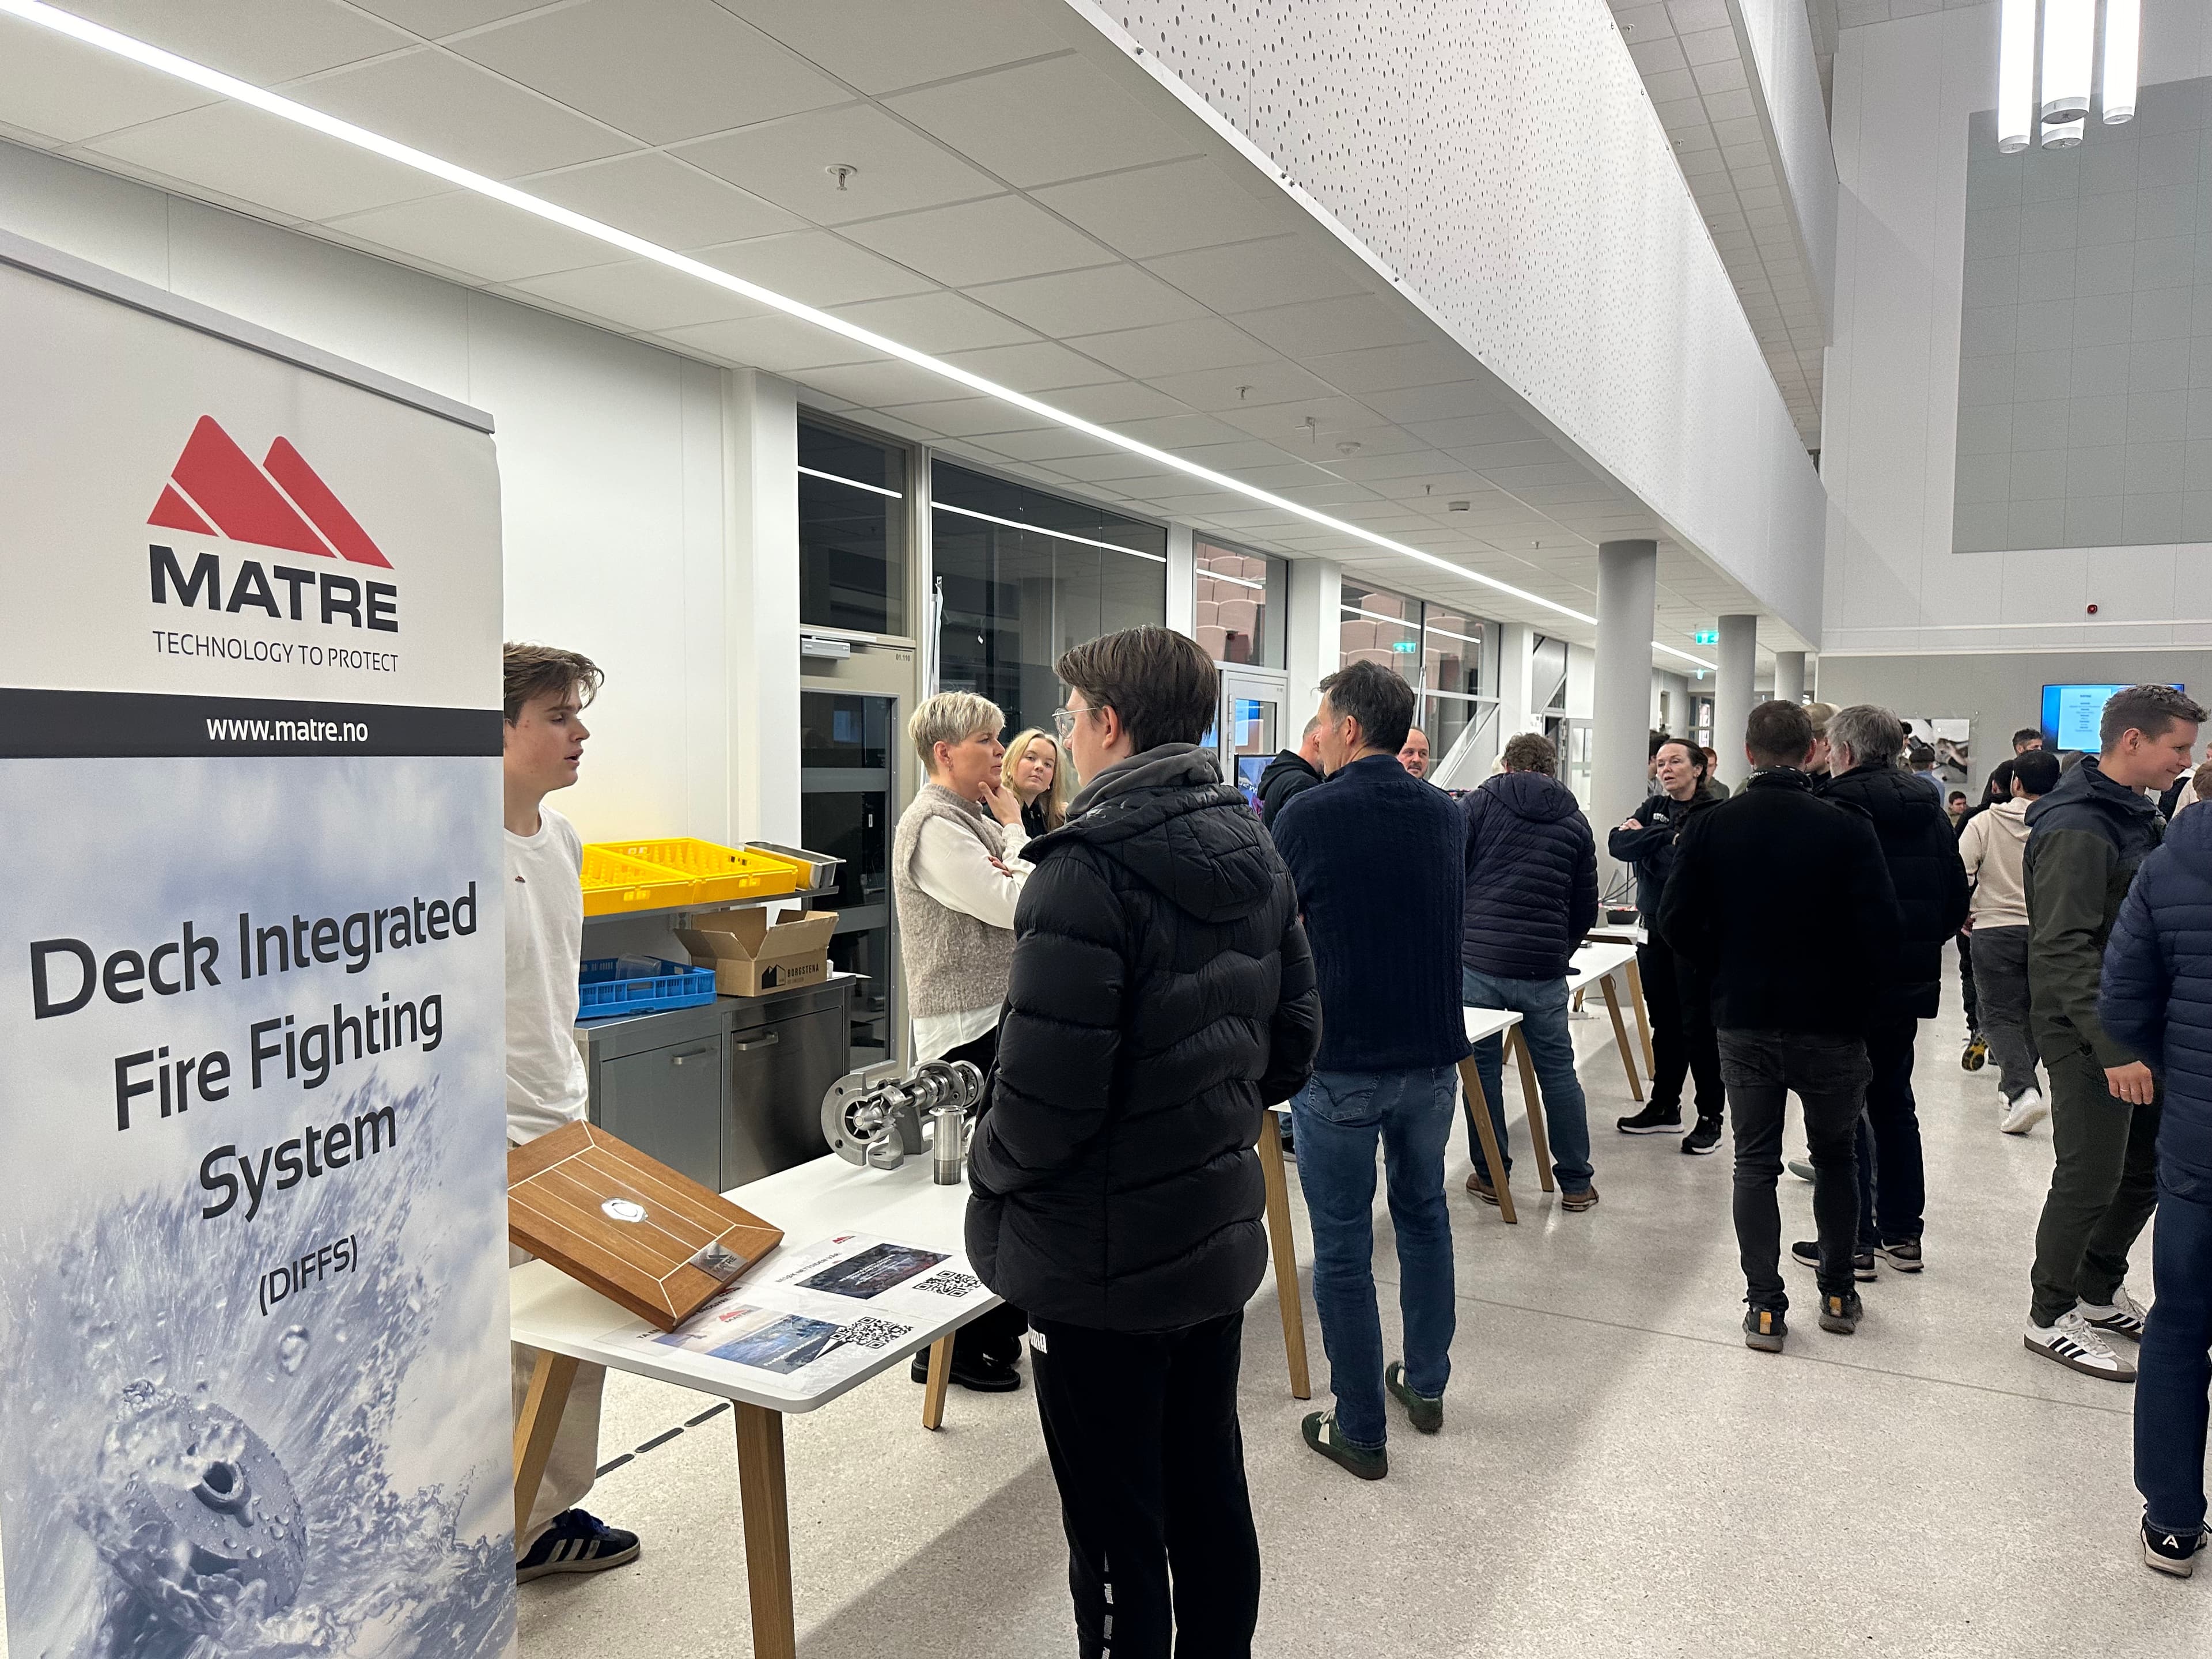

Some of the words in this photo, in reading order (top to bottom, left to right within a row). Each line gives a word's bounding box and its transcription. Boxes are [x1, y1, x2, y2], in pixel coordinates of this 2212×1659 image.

[149, 544, 399, 632] MATRE
[152, 630, 294, 665] TECHNOLOGY
[298, 645, 323, 666] TO
[328, 649, 399, 672] PROTECT
[206, 718, 369, 743] www.matre.no
[30, 921, 222, 1020] Deck
[239, 881, 477, 974] Integrated
[787, 963, 819, 977] BORGSTENA
[115, 1046, 231, 1131] Fire
[251, 992, 442, 1090] Fighting
[200, 1106, 396, 1222] System
[259, 1234, 358, 1317] (DIFFS)
[711, 1255, 737, 1272] MATRE
